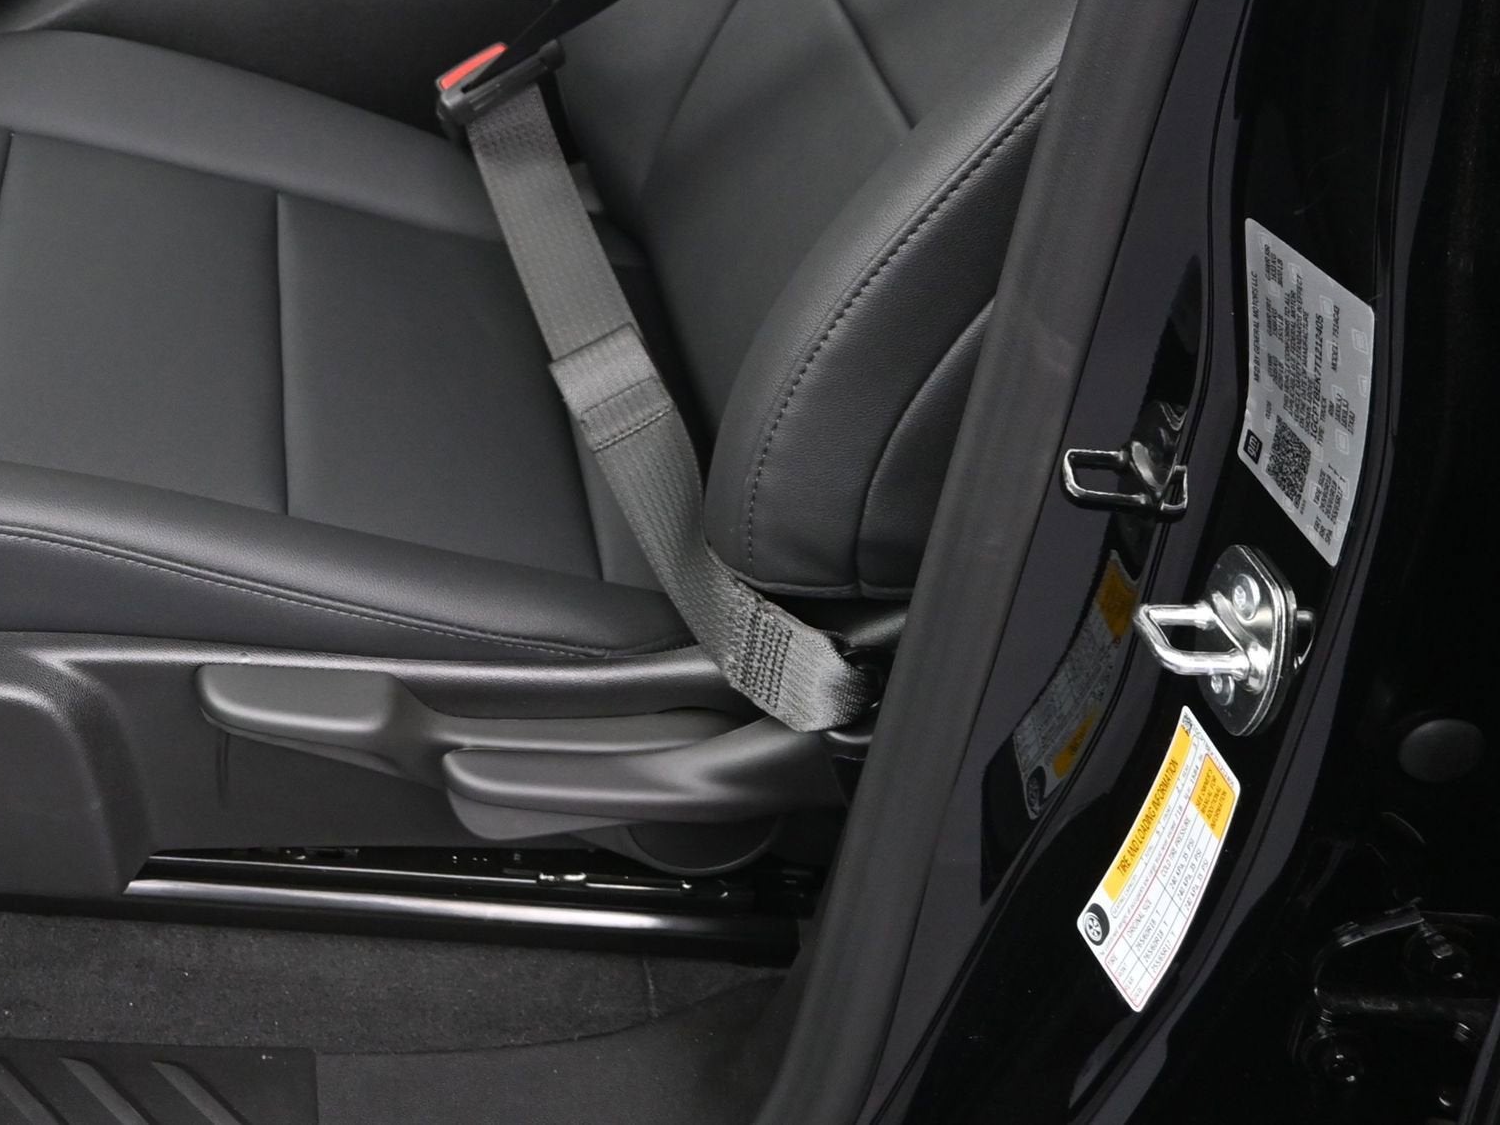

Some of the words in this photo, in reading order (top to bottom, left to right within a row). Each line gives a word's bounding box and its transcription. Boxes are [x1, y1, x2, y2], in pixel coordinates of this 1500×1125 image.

[1254, 356, 1260, 366] BY
[1313, 516, 1322, 532] FRT
[1117, 857, 1131, 876] TIRE
[1126, 840, 1139, 858] AND
[1133, 809, 1156, 843] LOADING
[1150, 757, 1178, 810] INFORMATION
[1210, 790, 1226, 830] INFORMATION
[1161, 859, 1172, 878] COLD
[1174, 816, 1191, 847] PRESSURE
[1185, 838, 1195, 851] PSI
[1192, 849, 1202, 861] PSI
[1200, 859, 1209, 872] PSI
